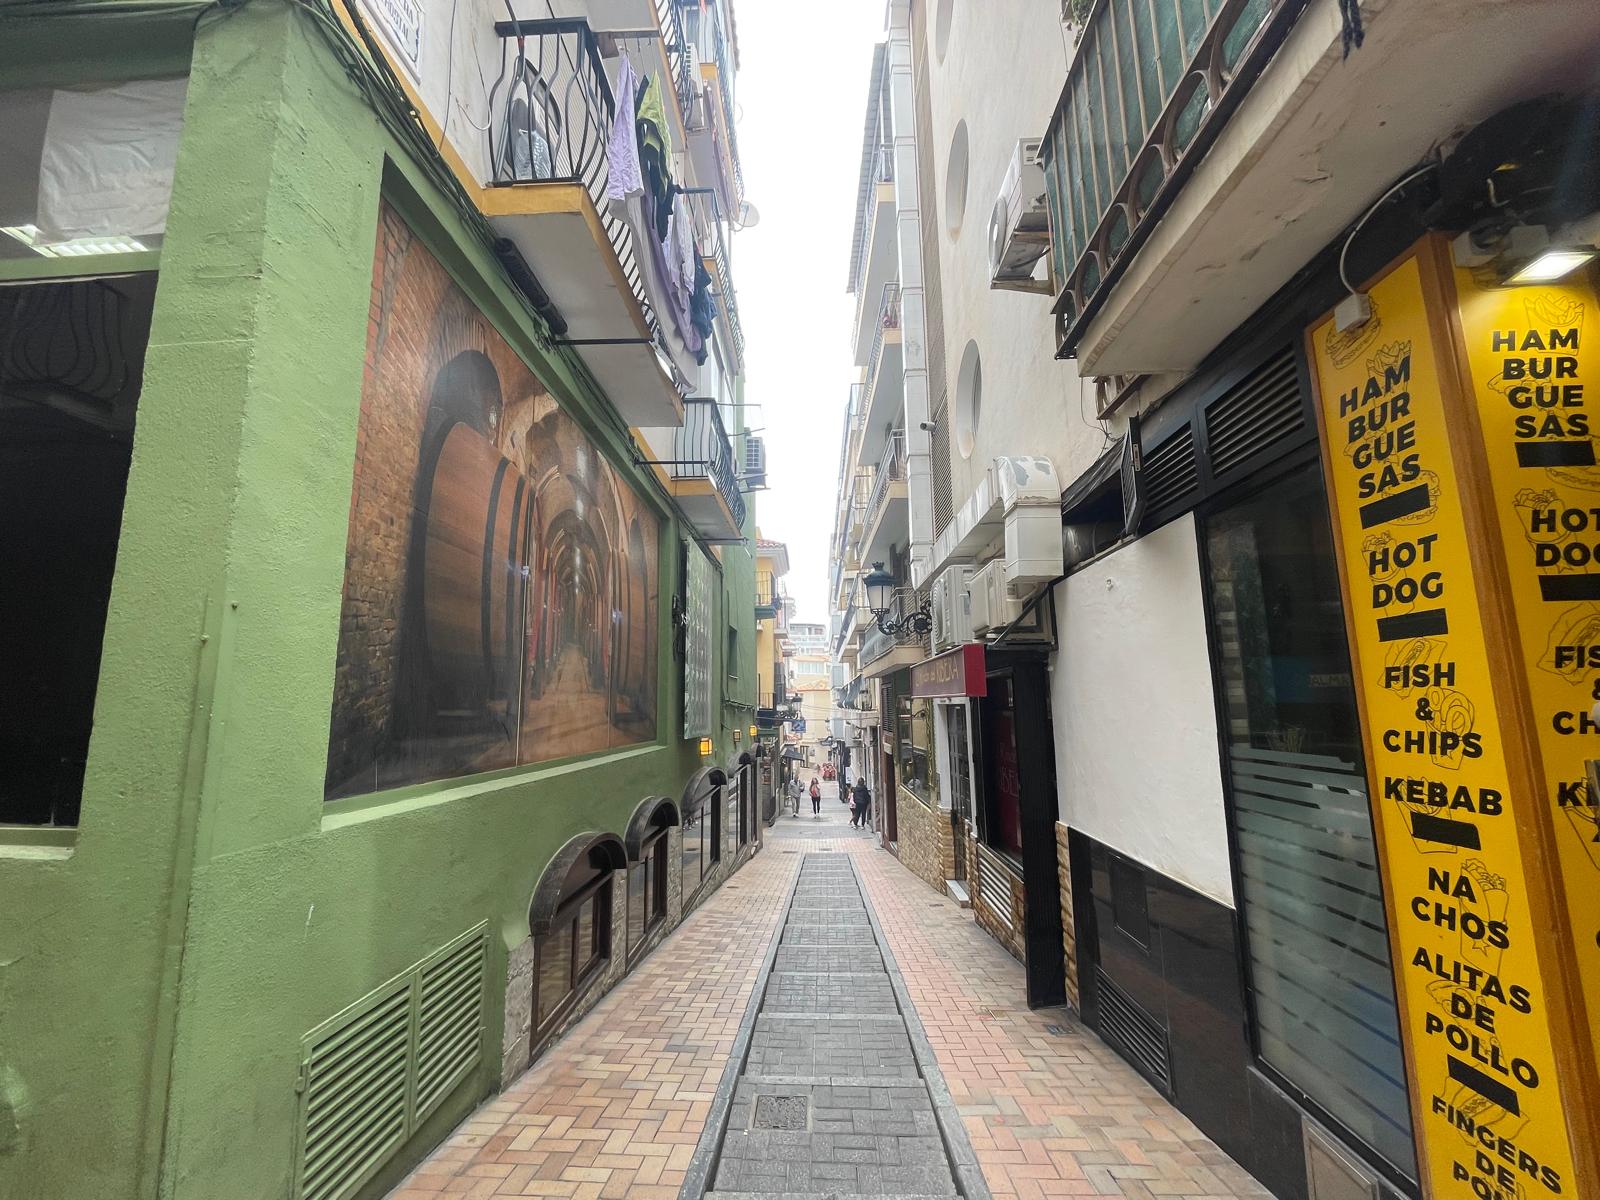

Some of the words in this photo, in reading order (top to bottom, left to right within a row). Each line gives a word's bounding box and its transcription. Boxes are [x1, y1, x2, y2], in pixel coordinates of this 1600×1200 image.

[1491, 328, 1579, 352] HAM
[1339, 355, 1411, 418] HAM
[1502, 357, 1579, 380] BUR
[1348, 391, 1411, 444] BUR
[1508, 384, 1584, 409] GUE
[1353, 420, 1416, 470] GUE
[1514, 413, 1590, 439] SAS
[1358, 453, 1422, 499] SAS
[1368, 533, 1438, 576] HOT
[1372, 571, 1444, 609] DOG
[1384, 662, 1456, 689] FISH
[1415, 697, 1434, 721] &
[1383, 729, 1483, 759] CHIPS
[1384, 776, 1503, 816] KEBAB
[1428, 867, 1477, 904] NA
[1411, 896, 1510, 950] CHOS
[1412, 946, 1532, 1014] ALITAS
[1451, 992, 1495, 1034] DE
[1425, 1012, 1539, 1089] POLLO
[1432, 1094, 1562, 1195] FINGERS
[1475, 1150, 1516, 1194] DE
